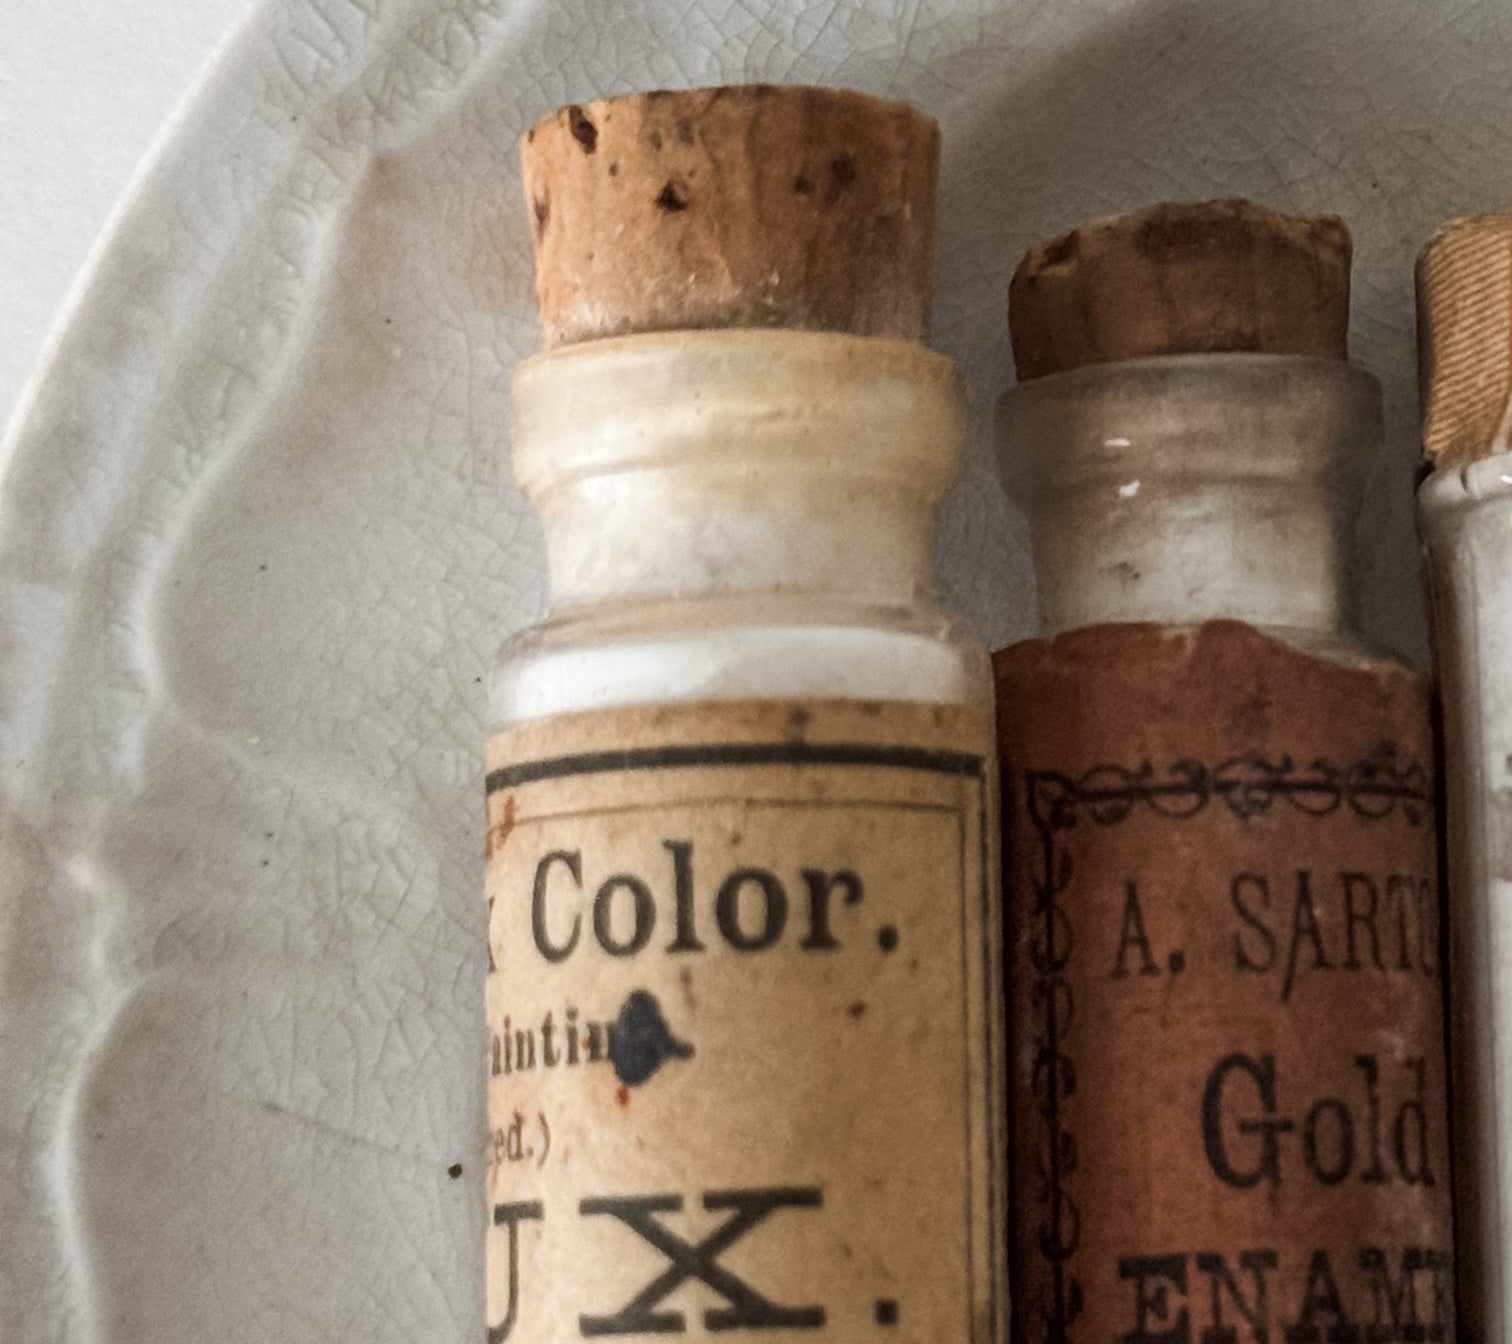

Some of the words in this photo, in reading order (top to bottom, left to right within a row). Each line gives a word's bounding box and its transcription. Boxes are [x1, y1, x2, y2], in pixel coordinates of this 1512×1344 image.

[531, 840, 900, 964] Color.
[1112, 878, 1186, 980] A.
[1200, 1054, 1437, 1191] Gold
